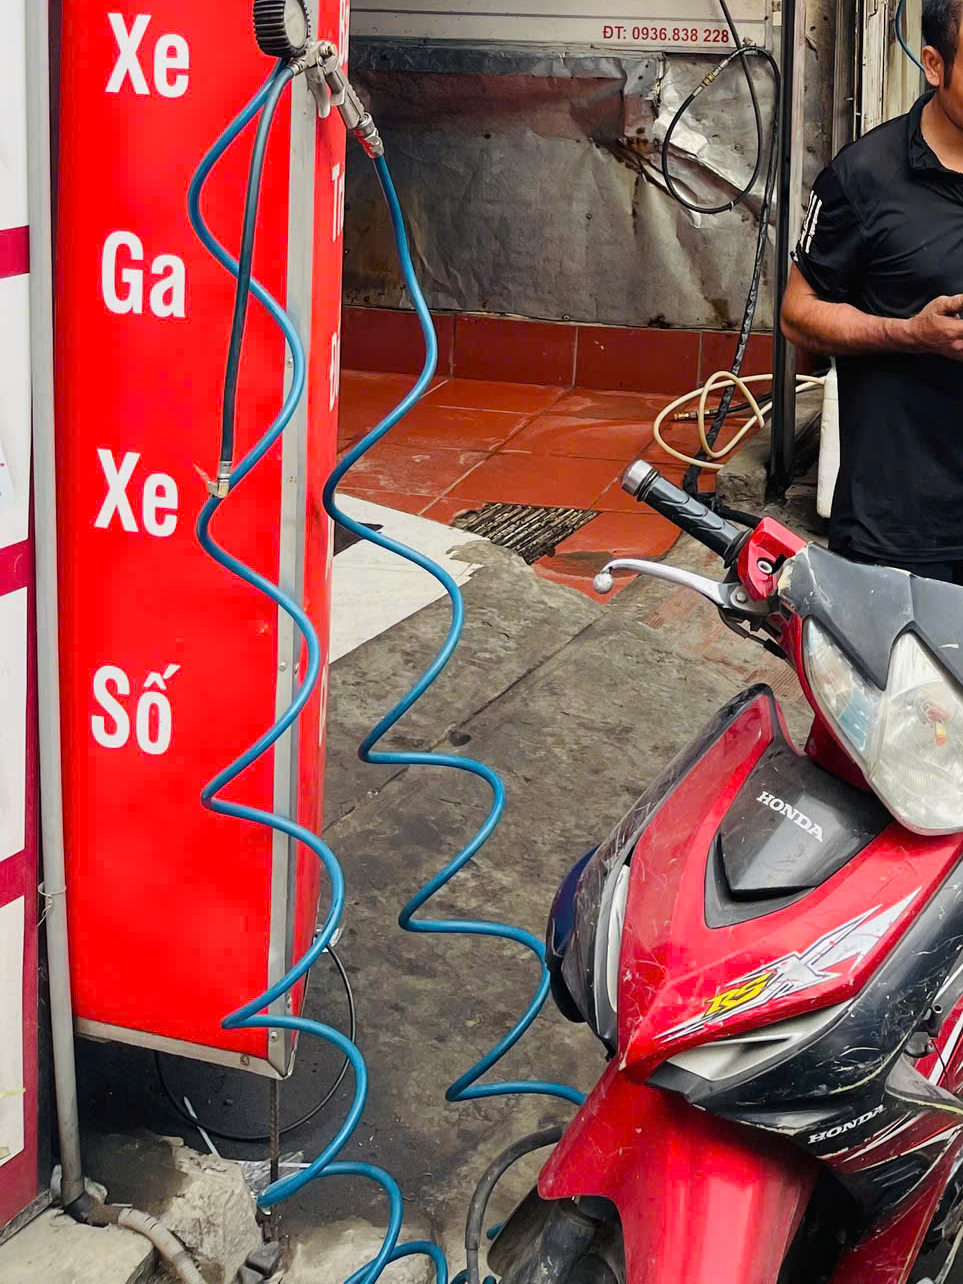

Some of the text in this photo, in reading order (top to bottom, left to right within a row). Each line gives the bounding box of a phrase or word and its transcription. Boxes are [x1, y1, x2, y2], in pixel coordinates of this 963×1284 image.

[105, 12, 190, 98] Xe
[603, 25, 730, 44] ĐT: 0936.838 228
[100, 230, 187, 319] Ga
[93, 447, 180, 537] Xe
[91, 663, 181, 755] Số
[755, 790, 824, 843] HONDA
[808, 1104, 887, 1145] HONDA
